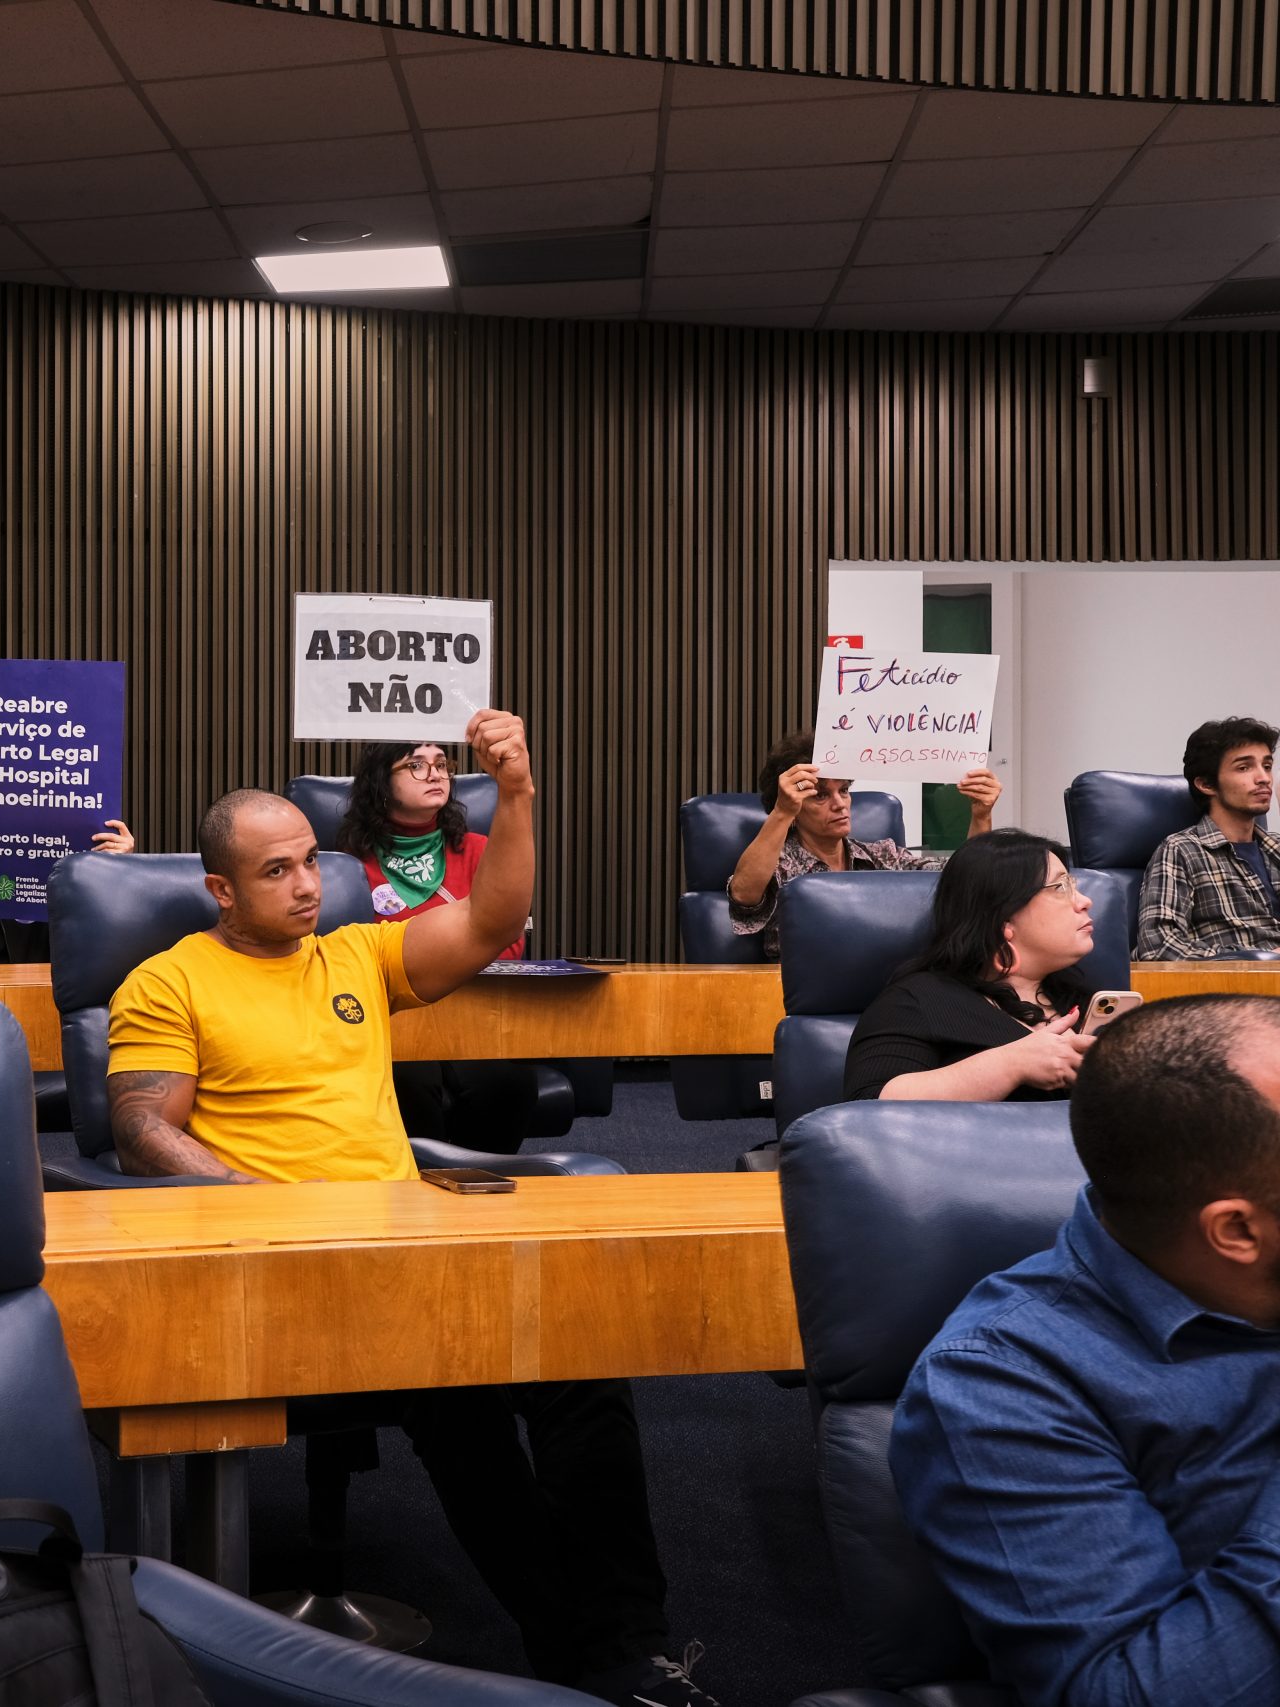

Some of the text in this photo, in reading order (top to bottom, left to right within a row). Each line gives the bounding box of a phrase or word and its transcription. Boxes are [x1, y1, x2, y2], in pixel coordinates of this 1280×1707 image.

[305, 629, 481, 665] ABORTO
[347, 673, 443, 715] NÃO
[57, 720, 86, 738] de
[866, 704, 982, 735] VIOLÊNCIA!
[39, 744, 99, 766] Legal
[33, 833, 70, 847] legal,
[15, 848, 25, 857] e
